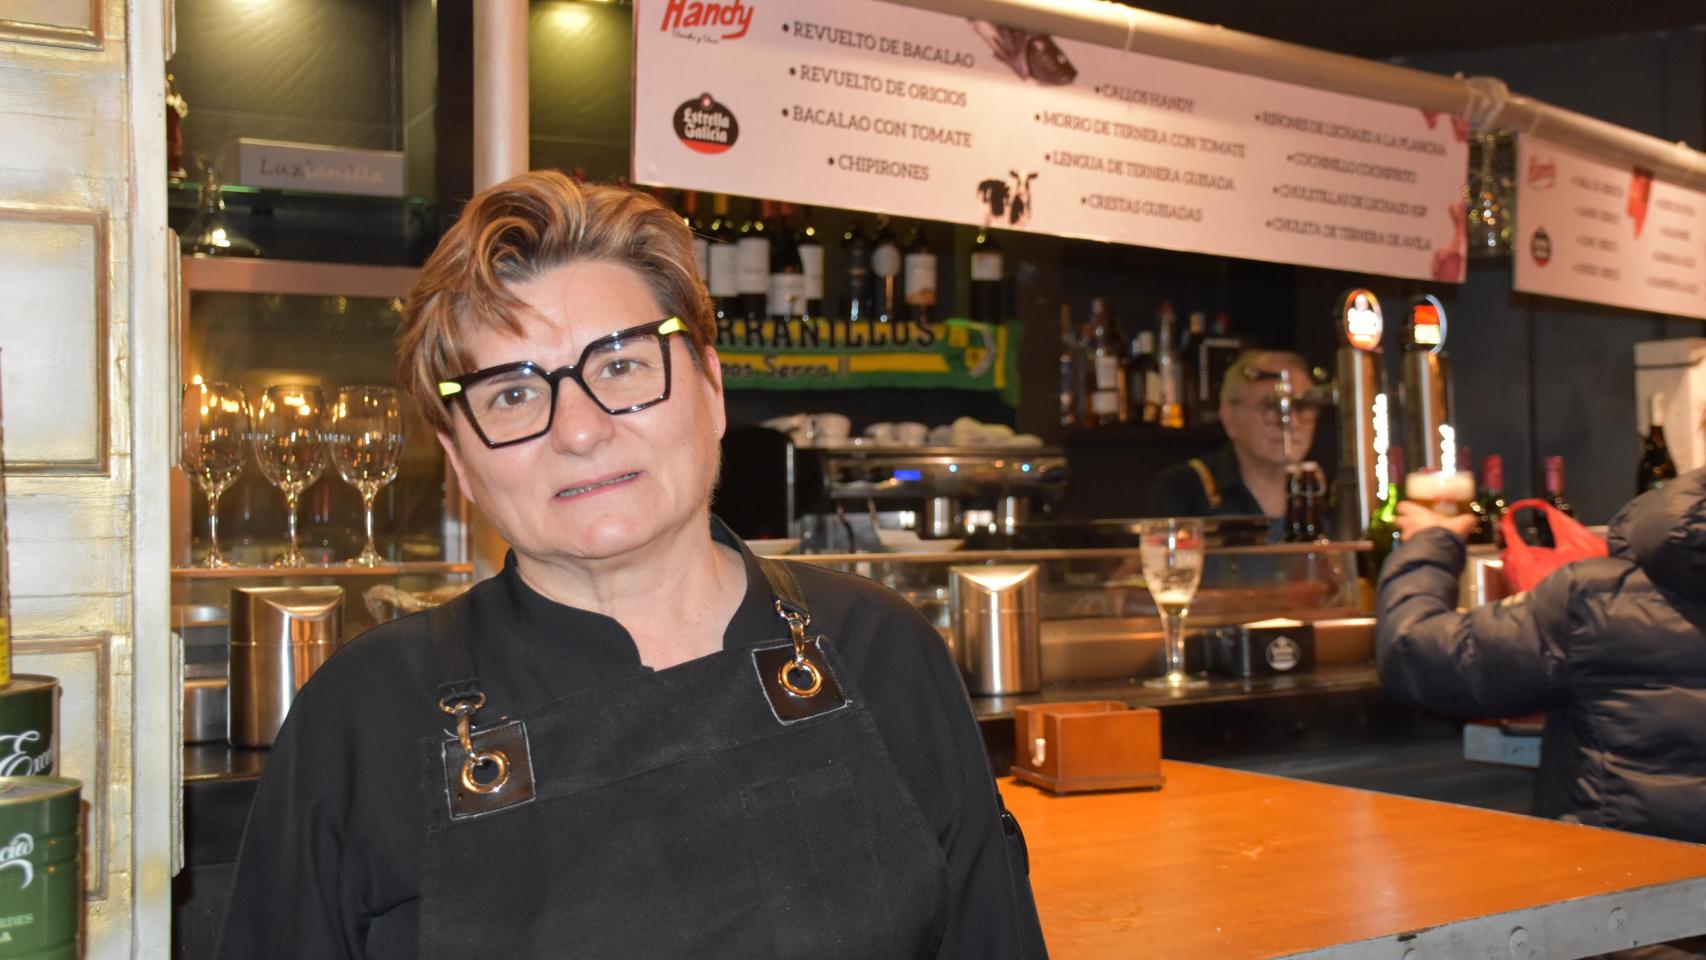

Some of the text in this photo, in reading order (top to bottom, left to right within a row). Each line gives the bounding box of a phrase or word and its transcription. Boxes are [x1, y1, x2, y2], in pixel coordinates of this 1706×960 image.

[661, 0, 754, 39] Handy
[793, 21, 975, 69] REVUELTO DE BACALAO
[800, 65, 967, 107] REVUELTO DE ORICIOS
[684, 107, 730, 129] Estrella
[684, 123, 728, 143] Galicia
[792, 105, 973, 148] BACALAO CON TOMATE
[1043, 110, 1245, 158] MORRO DE TERNERA CON TOMATE
[838, 154, 930, 181] CHIPIRONES
[1053, 150, 1104, 172] LENGUA
[1107, 158, 1122, 175] DE
[1127, 161, 1180, 183] TERNERA
